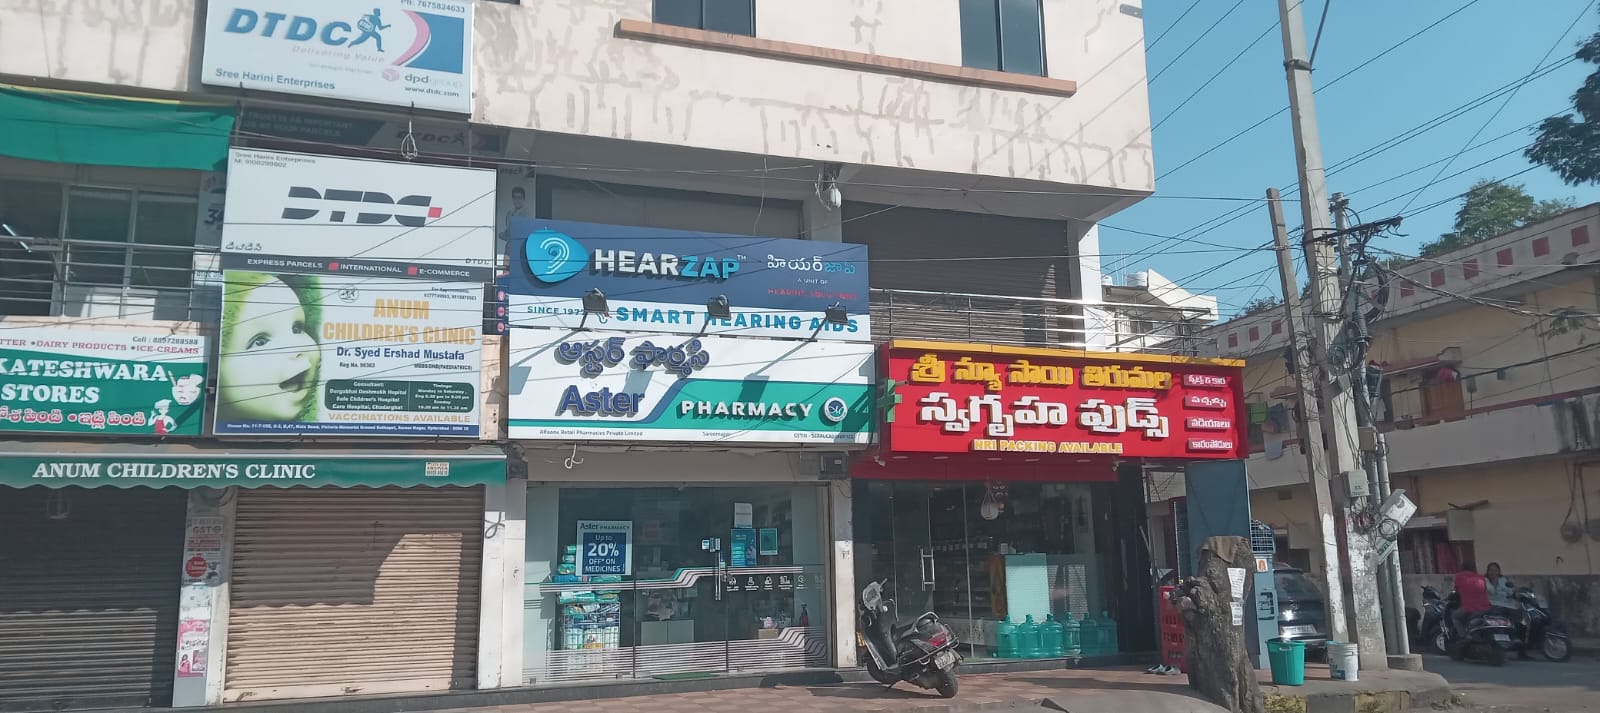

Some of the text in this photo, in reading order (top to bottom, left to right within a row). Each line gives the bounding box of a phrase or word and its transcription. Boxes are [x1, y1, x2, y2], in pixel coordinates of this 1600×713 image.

[224, 8, 351, 46] DTDC
[355, 53, 385, 63] Value
[215, 68, 336, 90] Sree Harini Enterprises
[404, 87, 460, 97] www.dtdc.com
[281, 186, 432, 227] DTDC
[286, 260, 323, 268] PARCELS
[340, 263, 402, 273] INTERNATIONAL
[419, 268, 470, 277] E-COMMERCE
[594, 248, 740, 280] HEARZAP
[373, 298, 430, 320] ANUM
[527, 305, 559, 315] SINCE
[616, 306, 858, 332] SMART HEARING AIDS
[323, 322, 476, 345] CHILDREN'S CLINIC
[36, 340, 68, 348] DAIRY
[72, 342, 127, 351] PRODUCTS
[336, 346, 465, 361] Dr. Syed Ershad Mustafa
[1, 383, 100, 404] STORES
[559, 384, 645, 414] Aster
[681, 400, 813, 417] PHARMACY
[328, 413, 471, 423] VACCINATIONS AVAILABLE
[973, 439, 1123, 454] NRI PACKING AVAILABLE
[32, 463, 316, 479] ANUM CHILDREN'S CLINIC
[580, 522, 599, 530] Aster
[587, 542, 620, 557] 20%
